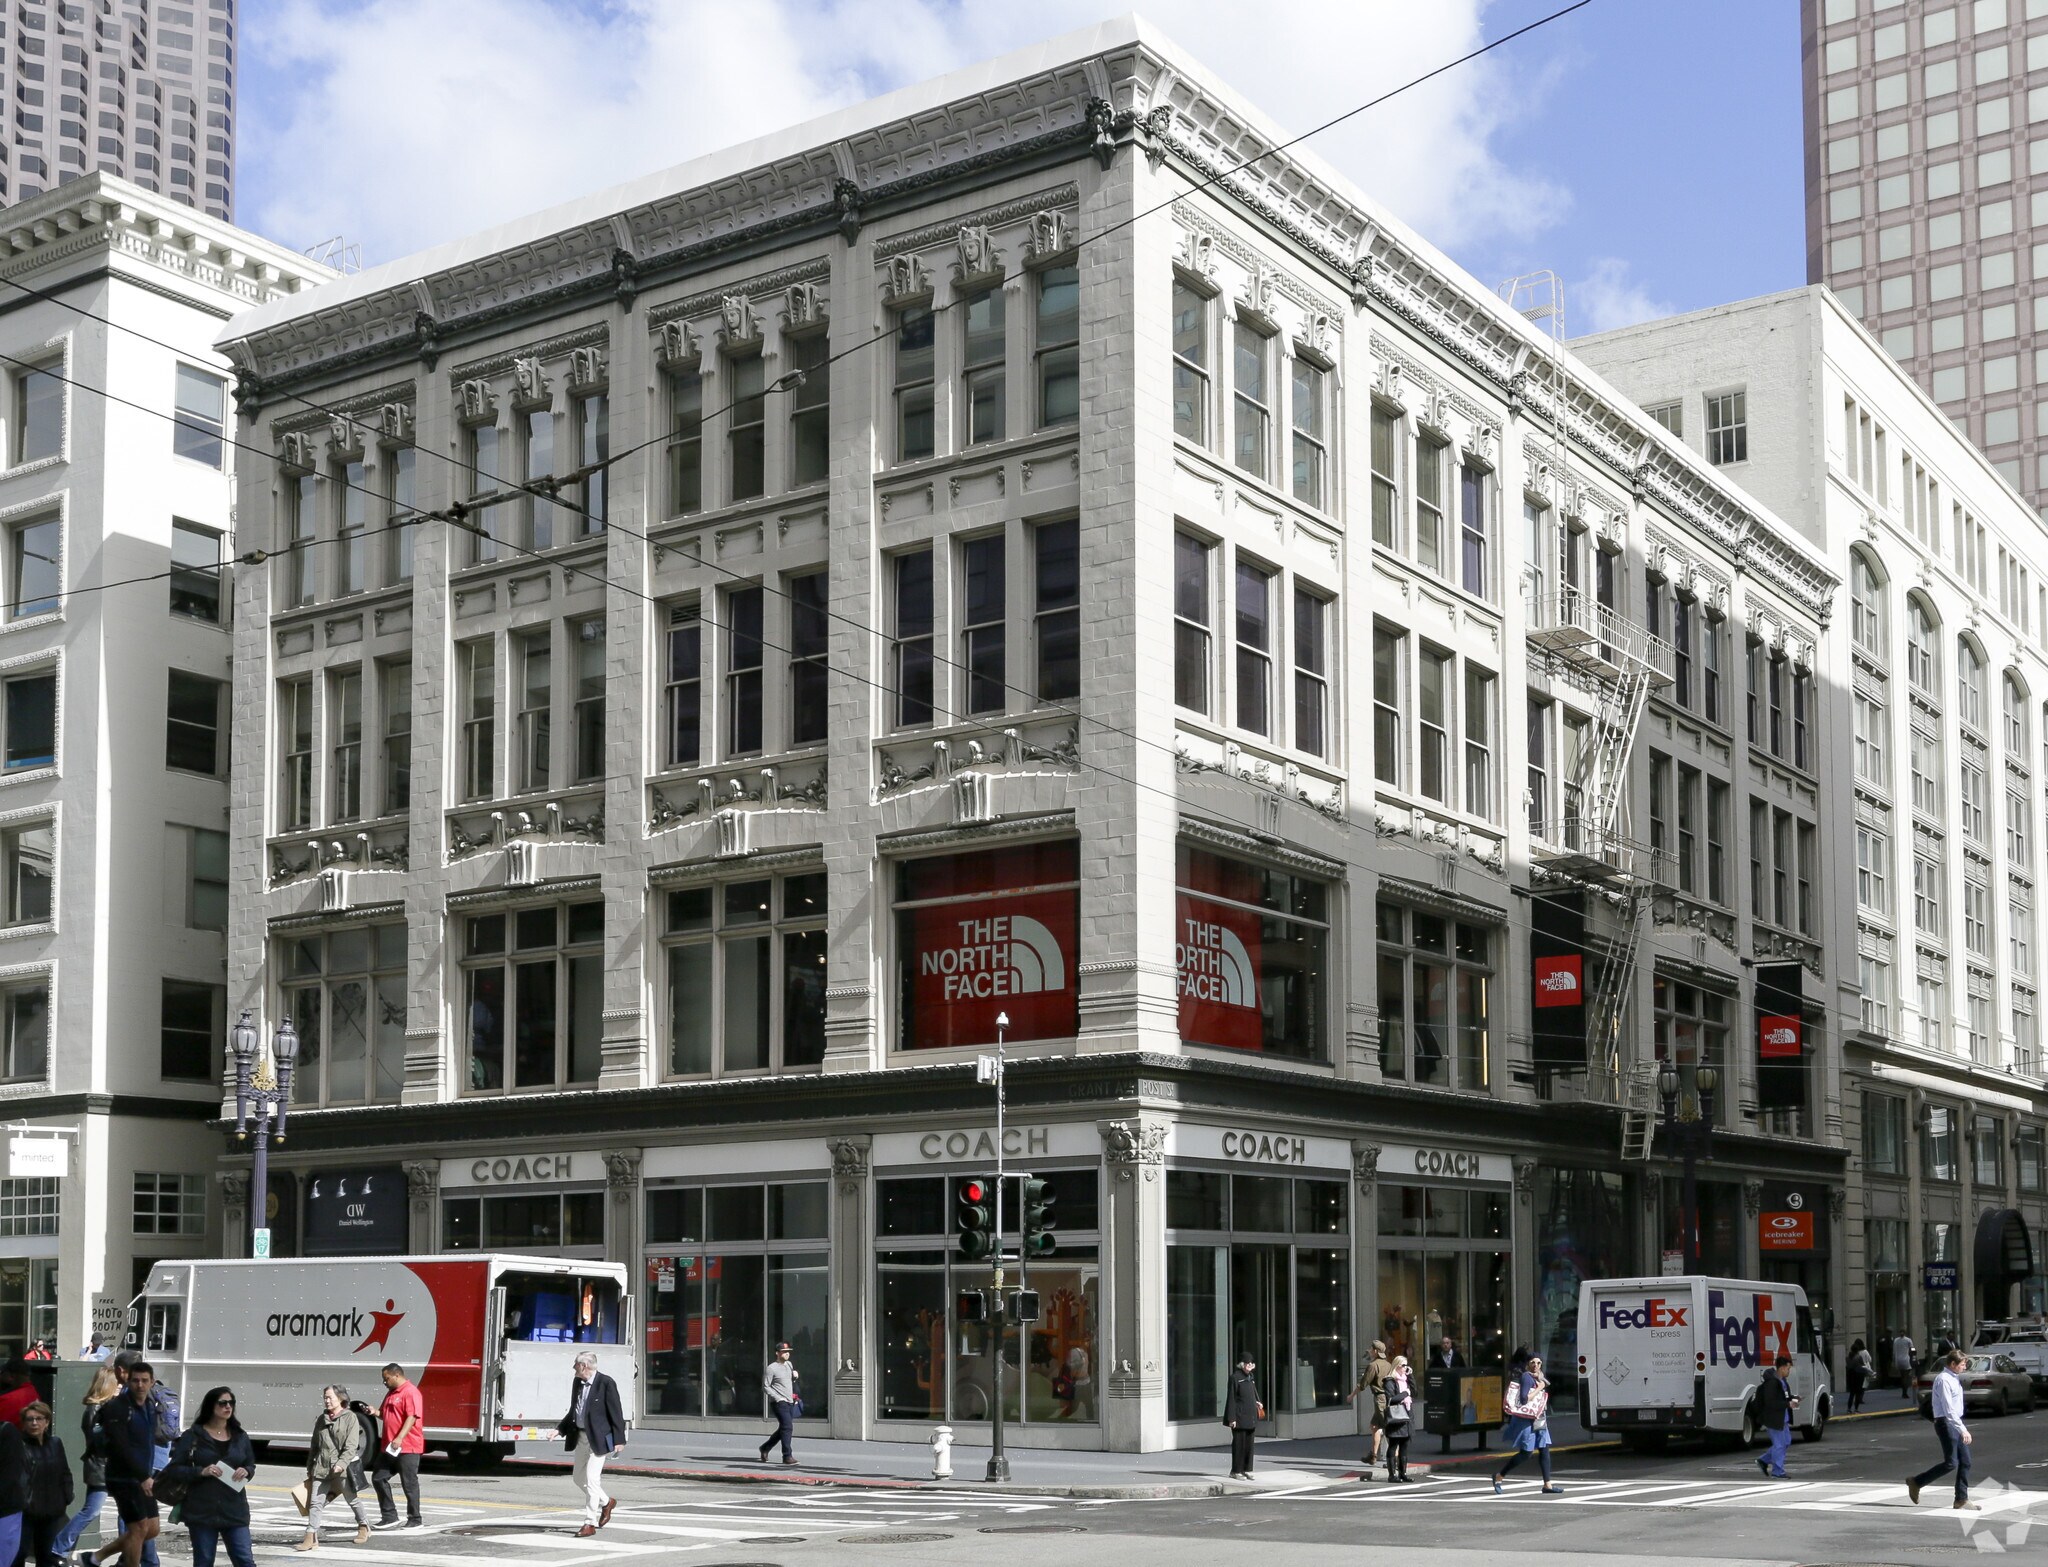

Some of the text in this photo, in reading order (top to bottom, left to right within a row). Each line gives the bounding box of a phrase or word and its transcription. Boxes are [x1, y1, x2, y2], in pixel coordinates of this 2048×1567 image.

[958, 916, 1009, 945] THE
[1185, 918, 1220, 949] THE
[922, 943, 1009, 976] NORTH
[1176, 942, 1220, 976] ORTH
[944, 970, 1009, 1000] FACE
[1177, 970, 1220, 1002] FACE
[1540, 977, 1564, 986] NORTH
[1546, 983, 1564, 991] FACE
[1550, 971, 1564, 979] THE
[1068, 1082, 1109, 1097] GRANT
[1142, 1080, 1164, 1095] POST
[21, 1152, 55, 1163] minted
[920, 1127, 1049, 1159] COACH
[1221, 1131, 1305, 1164] COACH
[471, 1155, 572, 1182] COACH
[1414, 1149, 1480, 1178] COACH
[92, 1307, 123, 1320] PHOTO
[92, 1320, 123, 1332] BOOTH
[266, 1306, 364, 1337] aramark
[1599, 1298, 1688, 1330] FedEx
[1650, 1329, 1681, 1339] Express
[1708, 1289, 1794, 1369] FedEx
